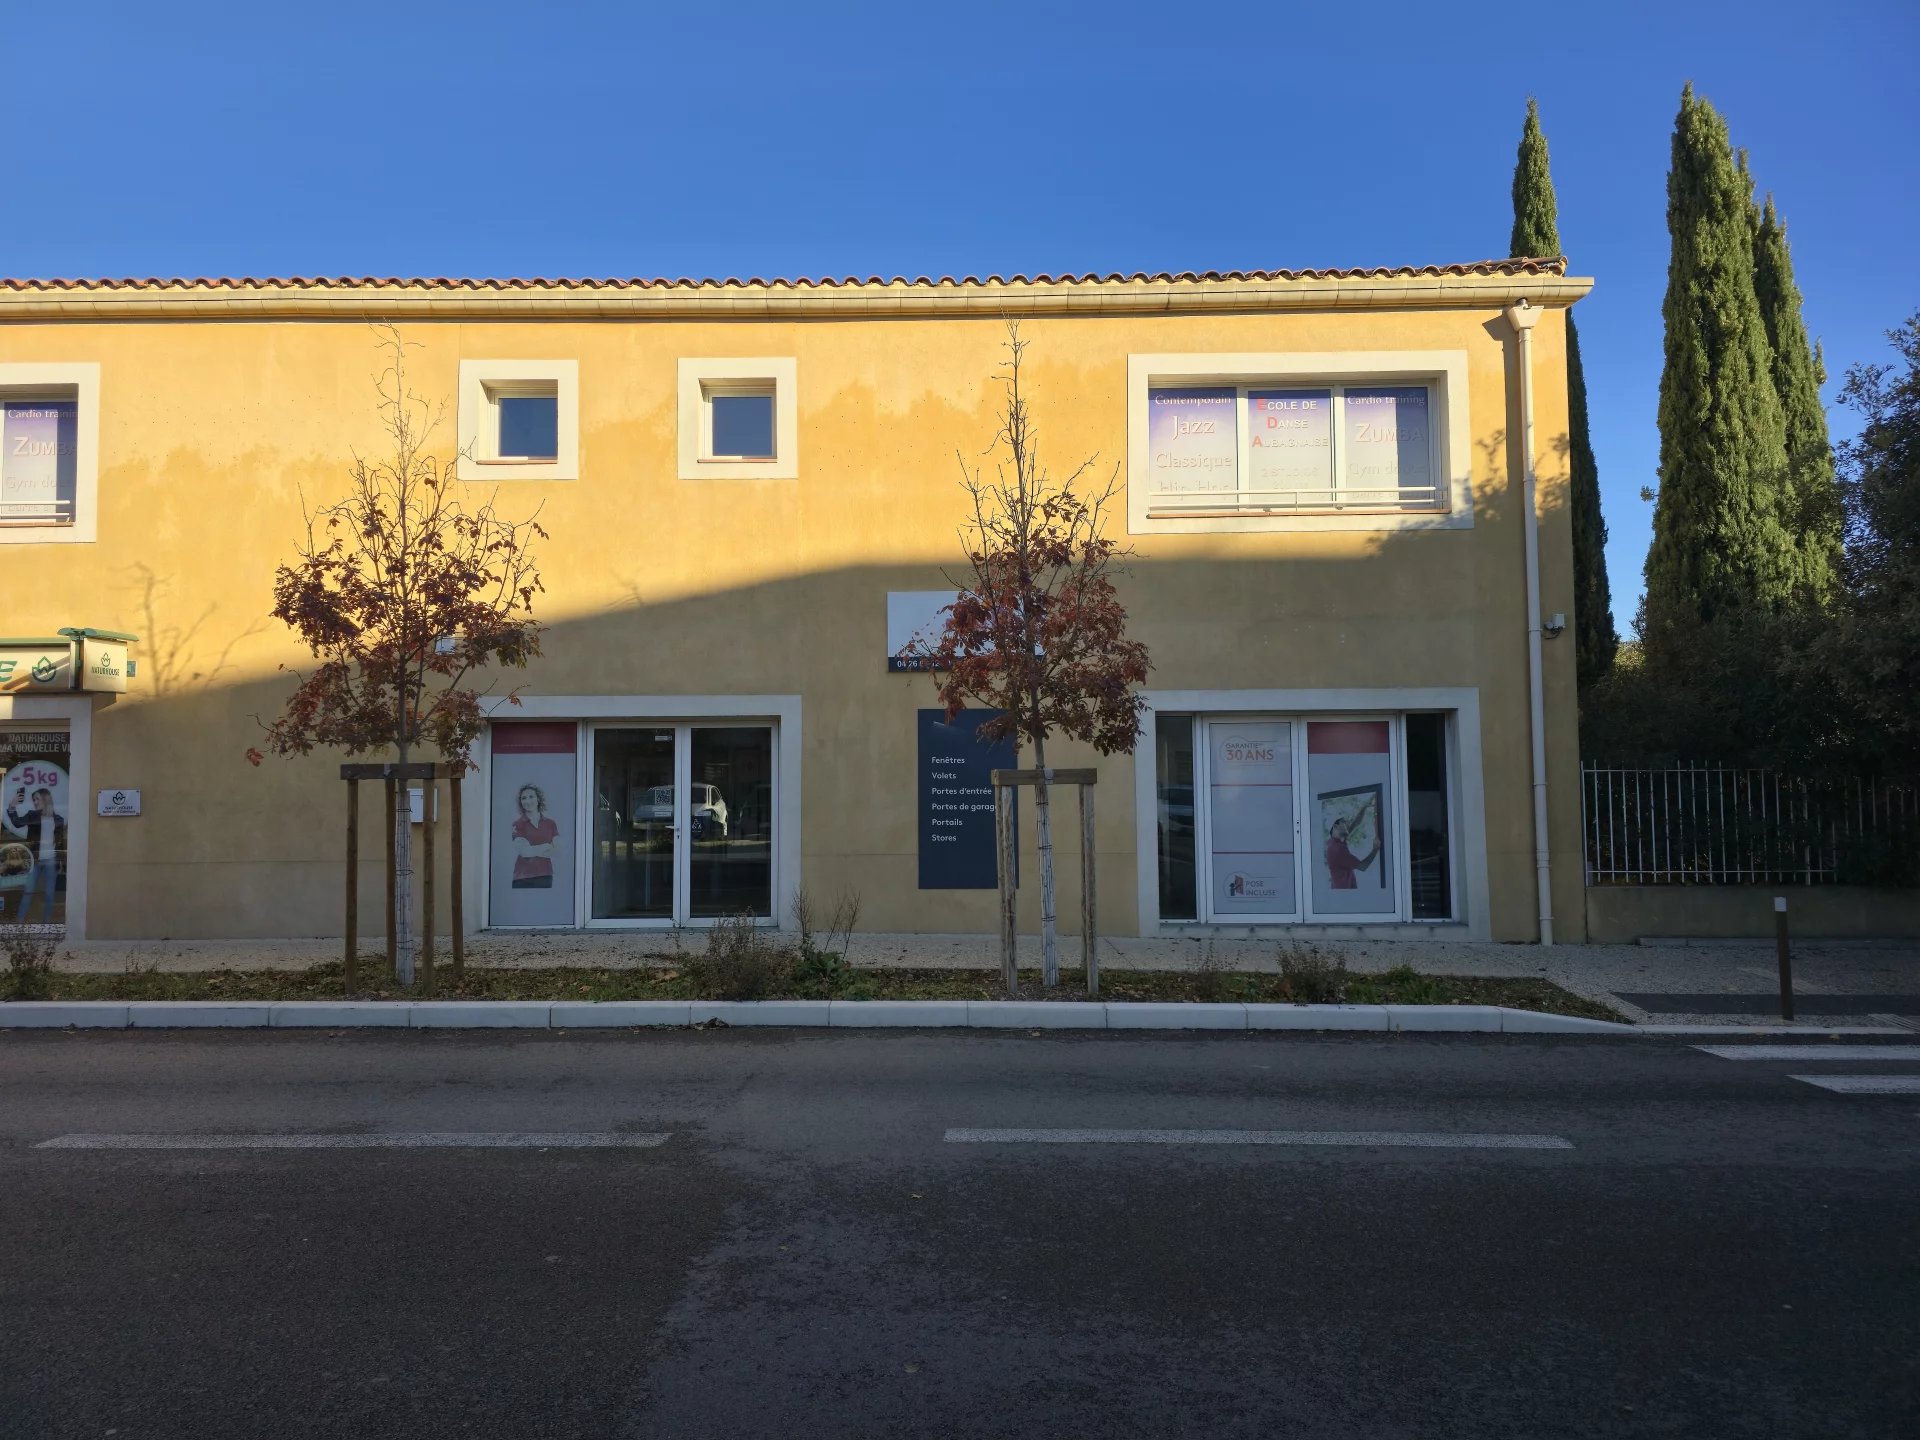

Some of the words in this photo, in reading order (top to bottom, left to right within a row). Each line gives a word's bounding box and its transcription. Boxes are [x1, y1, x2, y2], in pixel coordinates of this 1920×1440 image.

[1347, 396, 1382, 405] Cardio
[1385, 395, 1425, 406] training
[1302, 401, 1317, 410] DE
[8, 409, 42, 418] Cardio
[45, 409, 78, 418] trainin
[1267, 417, 1309, 429] DANSE
[1172, 416, 1215, 441] Jazz
[1354, 423, 1425, 443] ZUMBA
[1156, 451, 1232, 471] Classique
[9, 733, 66, 743] NATURHOUSE
[15, 743, 60, 753] NOUVELLE
[1226, 749, 1243, 760] 30
[1245, 749, 1275, 760] ANS
[931, 756, 965, 764] Fenêtres
[931, 772, 957, 780] Volets
[931, 787, 958, 795] Portes
[959, 787, 992, 795] d'entrée
[931, 803, 958, 811] Portes
[959, 803, 969, 811] de
[971, 803, 997, 812] garag
[931, 818, 963, 826] Portails
[931, 834, 957, 842] Stores
